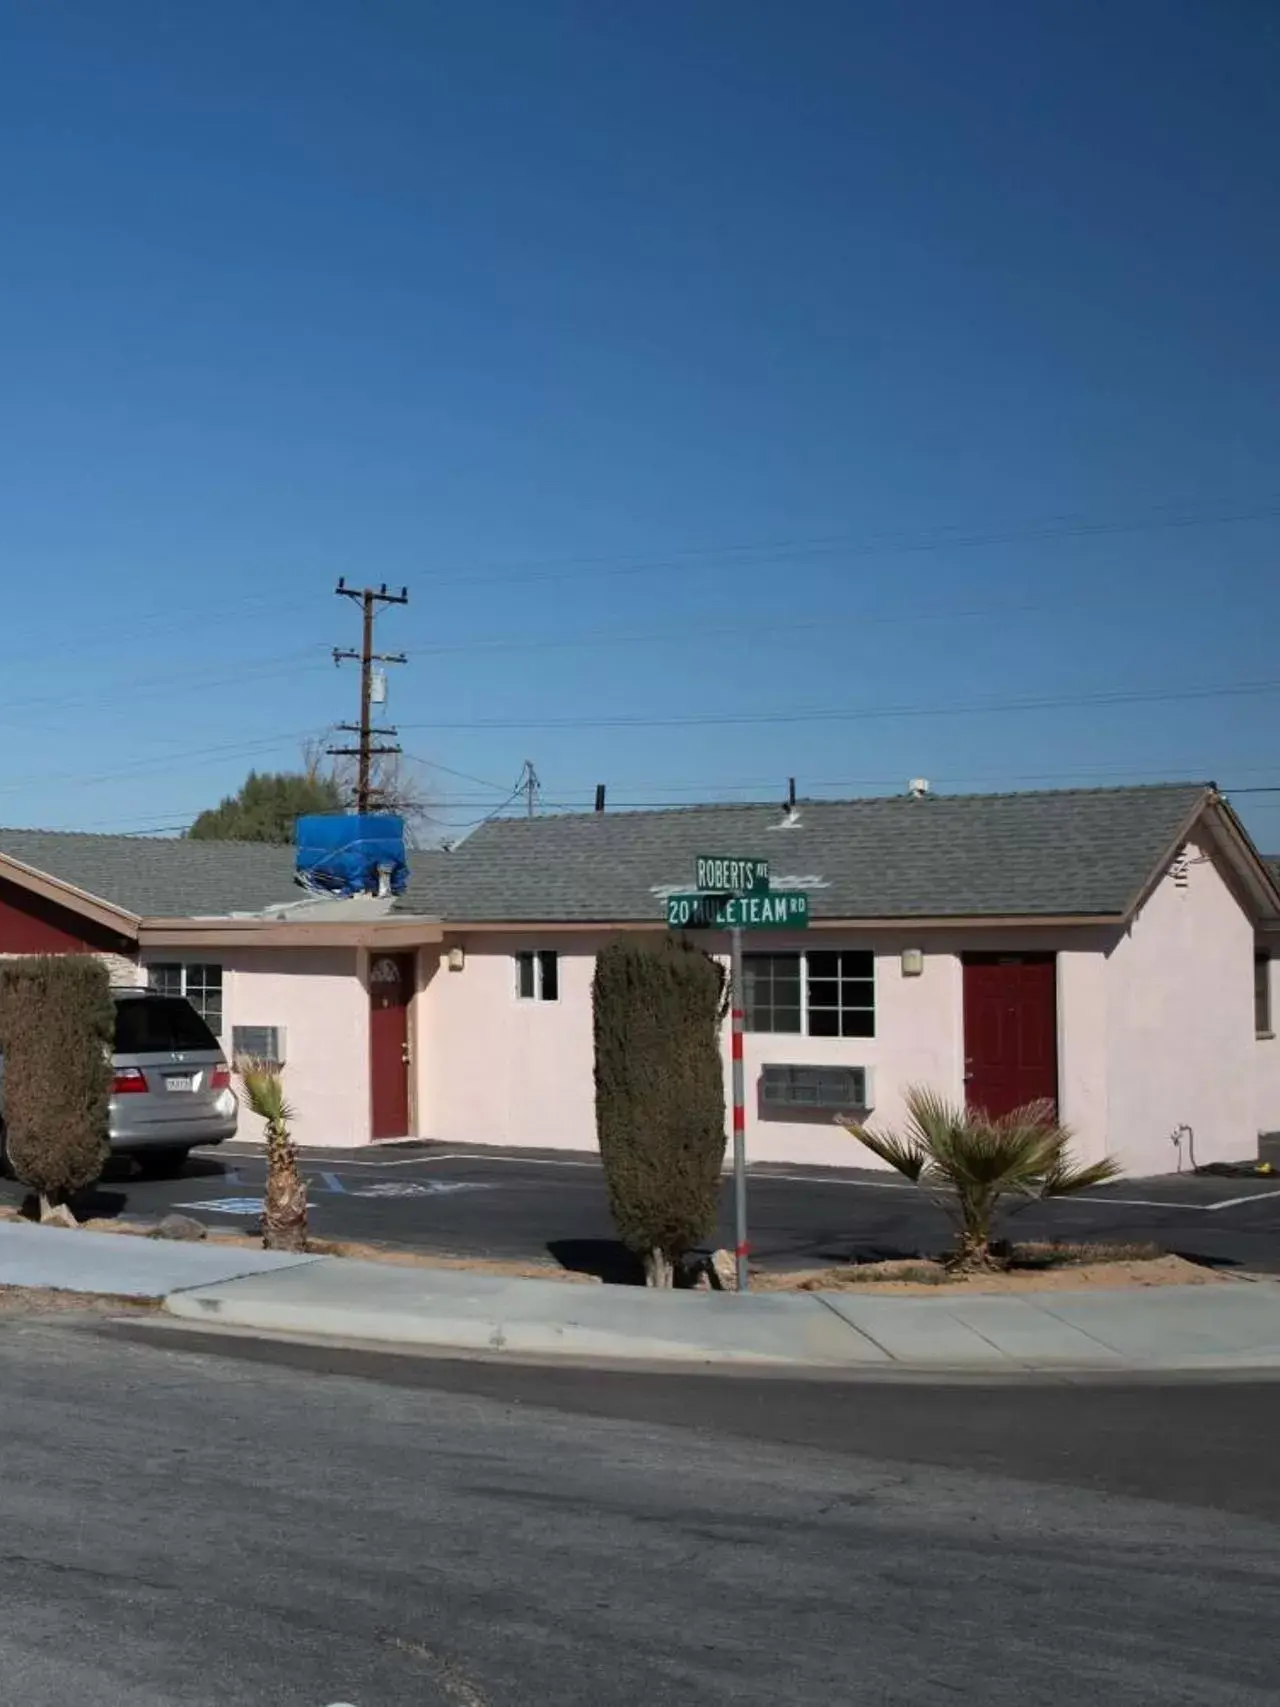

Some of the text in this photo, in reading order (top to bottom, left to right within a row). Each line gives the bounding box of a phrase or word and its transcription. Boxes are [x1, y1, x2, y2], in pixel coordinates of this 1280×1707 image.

[697, 858, 769, 889] ROBERTS AVE
[669, 901, 689, 924] 20
[740, 898, 788, 923] TEAM
[790, 898, 805, 912] RD
